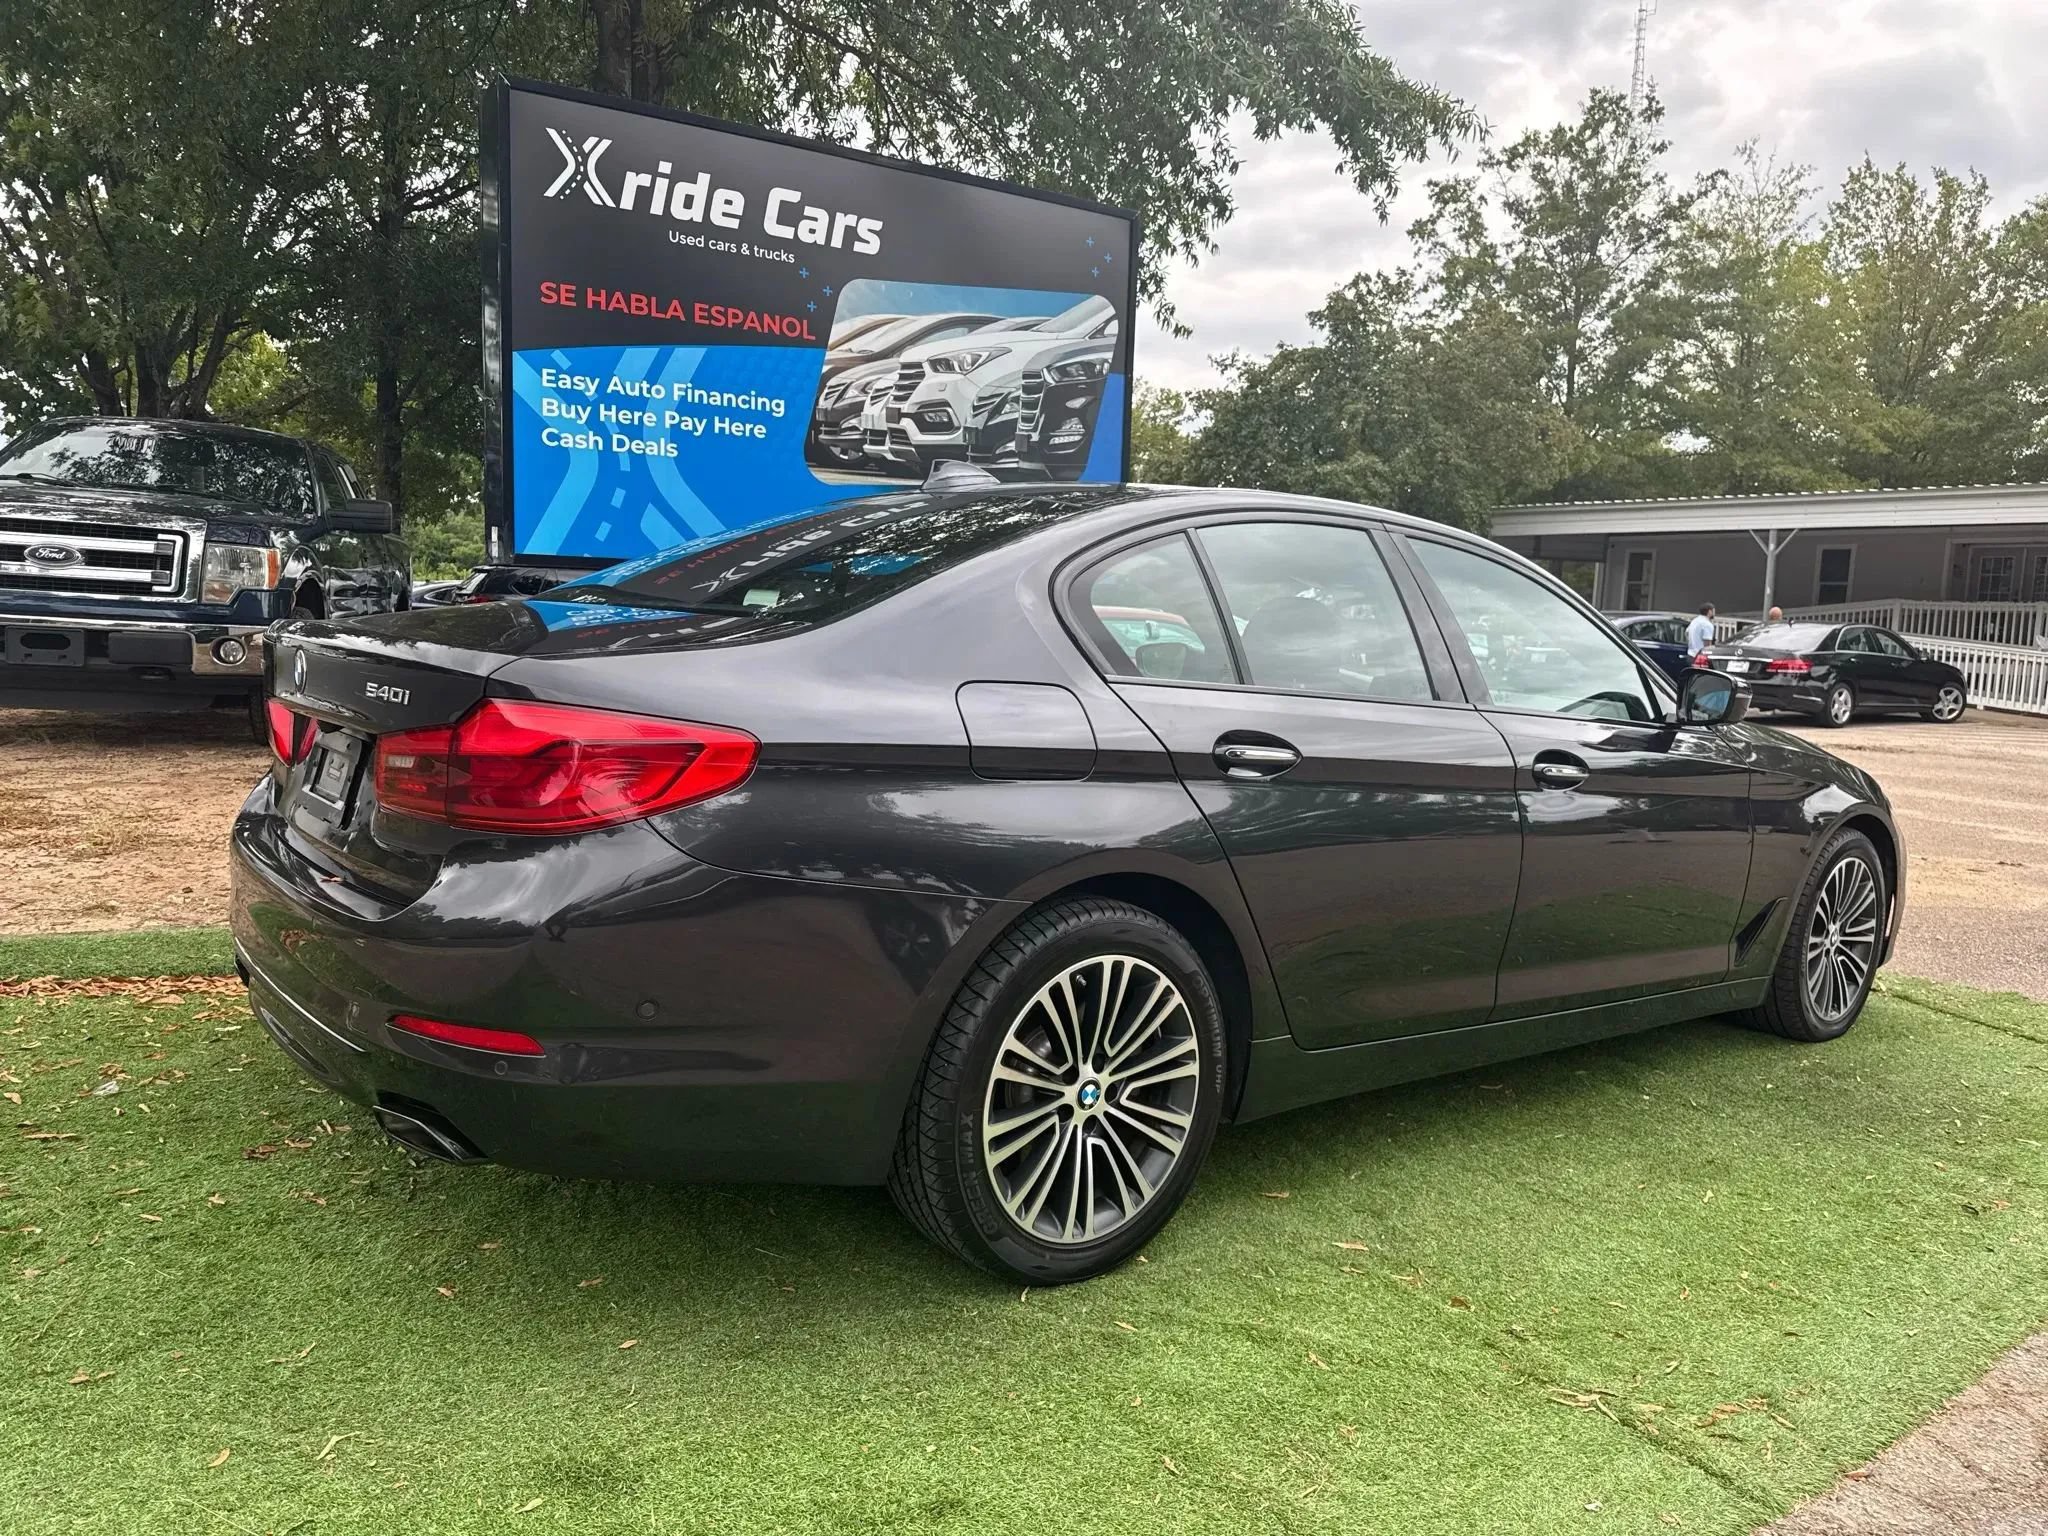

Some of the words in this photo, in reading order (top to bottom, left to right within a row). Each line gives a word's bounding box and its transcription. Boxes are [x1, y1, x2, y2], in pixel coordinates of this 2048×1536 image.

[763, 187, 884, 255] Cars
[669, 230, 705, 248] Used
[708, 239, 737, 254] cars
[740, 243, 751, 256] &
[753, 244, 795, 264] trucks
[540, 281, 577, 307] SE
[587, 287, 686, 321] HABLA
[694, 302, 816, 341] ESPANOL
[541, 368, 600, 396] Easy
[606, 375, 666, 400] Auto
[673, 382, 785, 418] Financing
[541, 398, 592, 425] Buy
[600, 403, 657, 429] Here
[664, 410, 707, 437] Pay
[714, 415, 767, 439] Here
[541, 427, 603, 451] Cash
[611, 433, 679, 458] Deals
[35, 547, 67, 560] Ford
[960, 1111, 975, 1164] MAX
